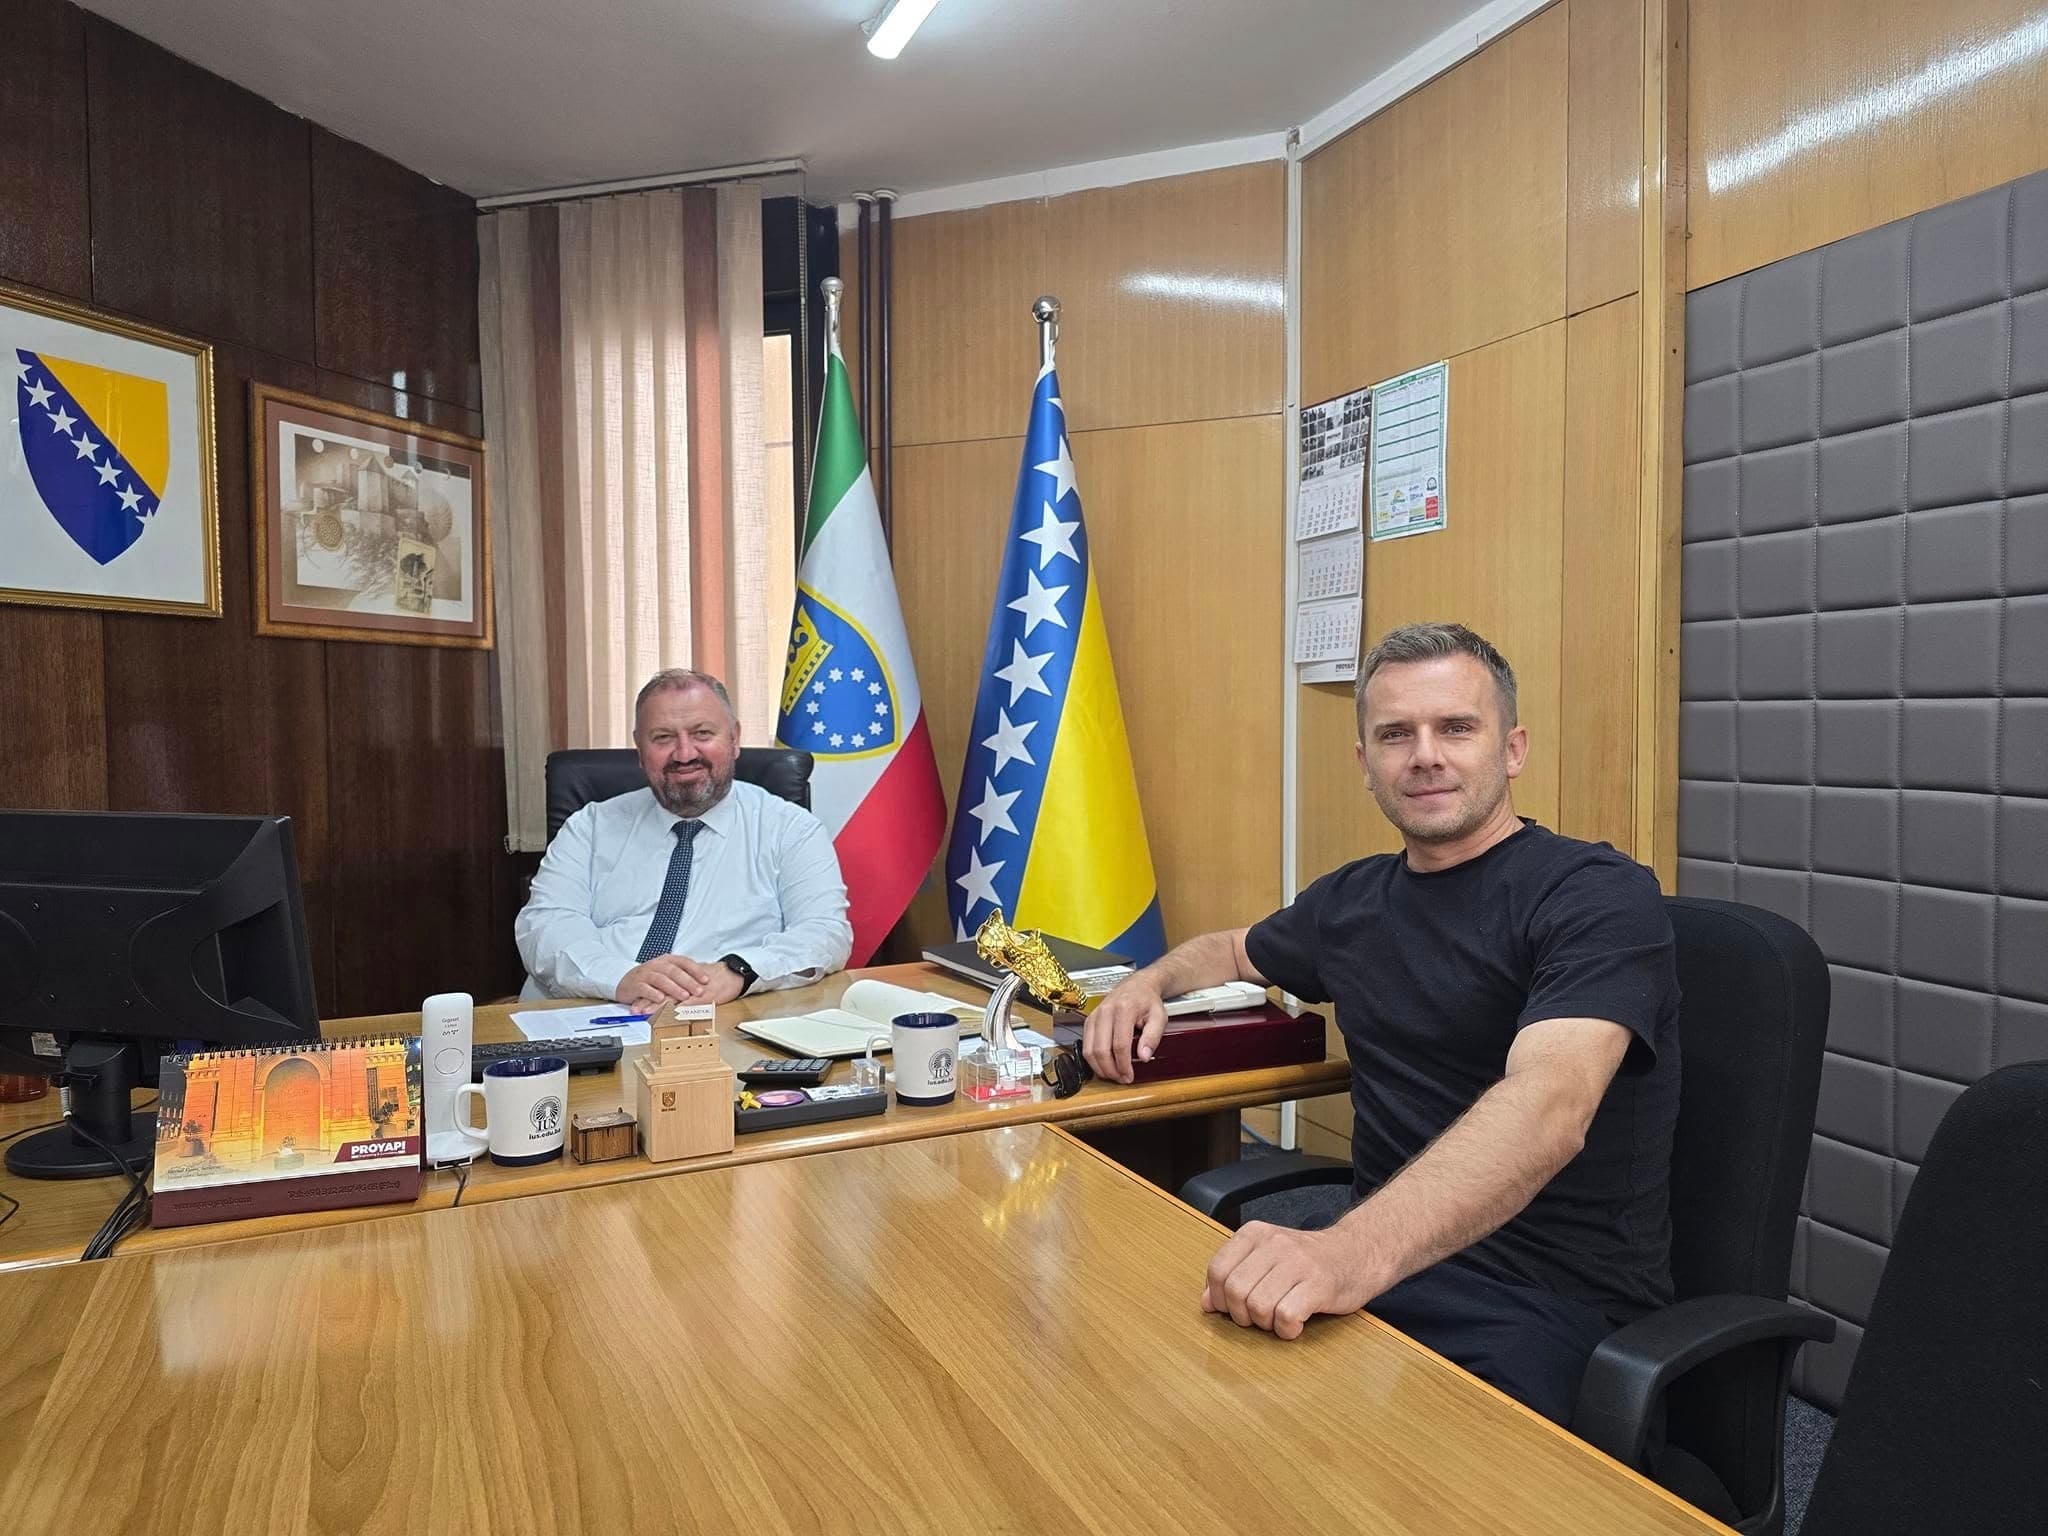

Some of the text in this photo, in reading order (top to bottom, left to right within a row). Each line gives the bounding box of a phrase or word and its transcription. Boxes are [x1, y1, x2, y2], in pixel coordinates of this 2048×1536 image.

[935, 1068, 950, 1079] IUS
[538, 1118, 556, 1131] IUS
[351, 1141, 406, 1154] PROYAPI
